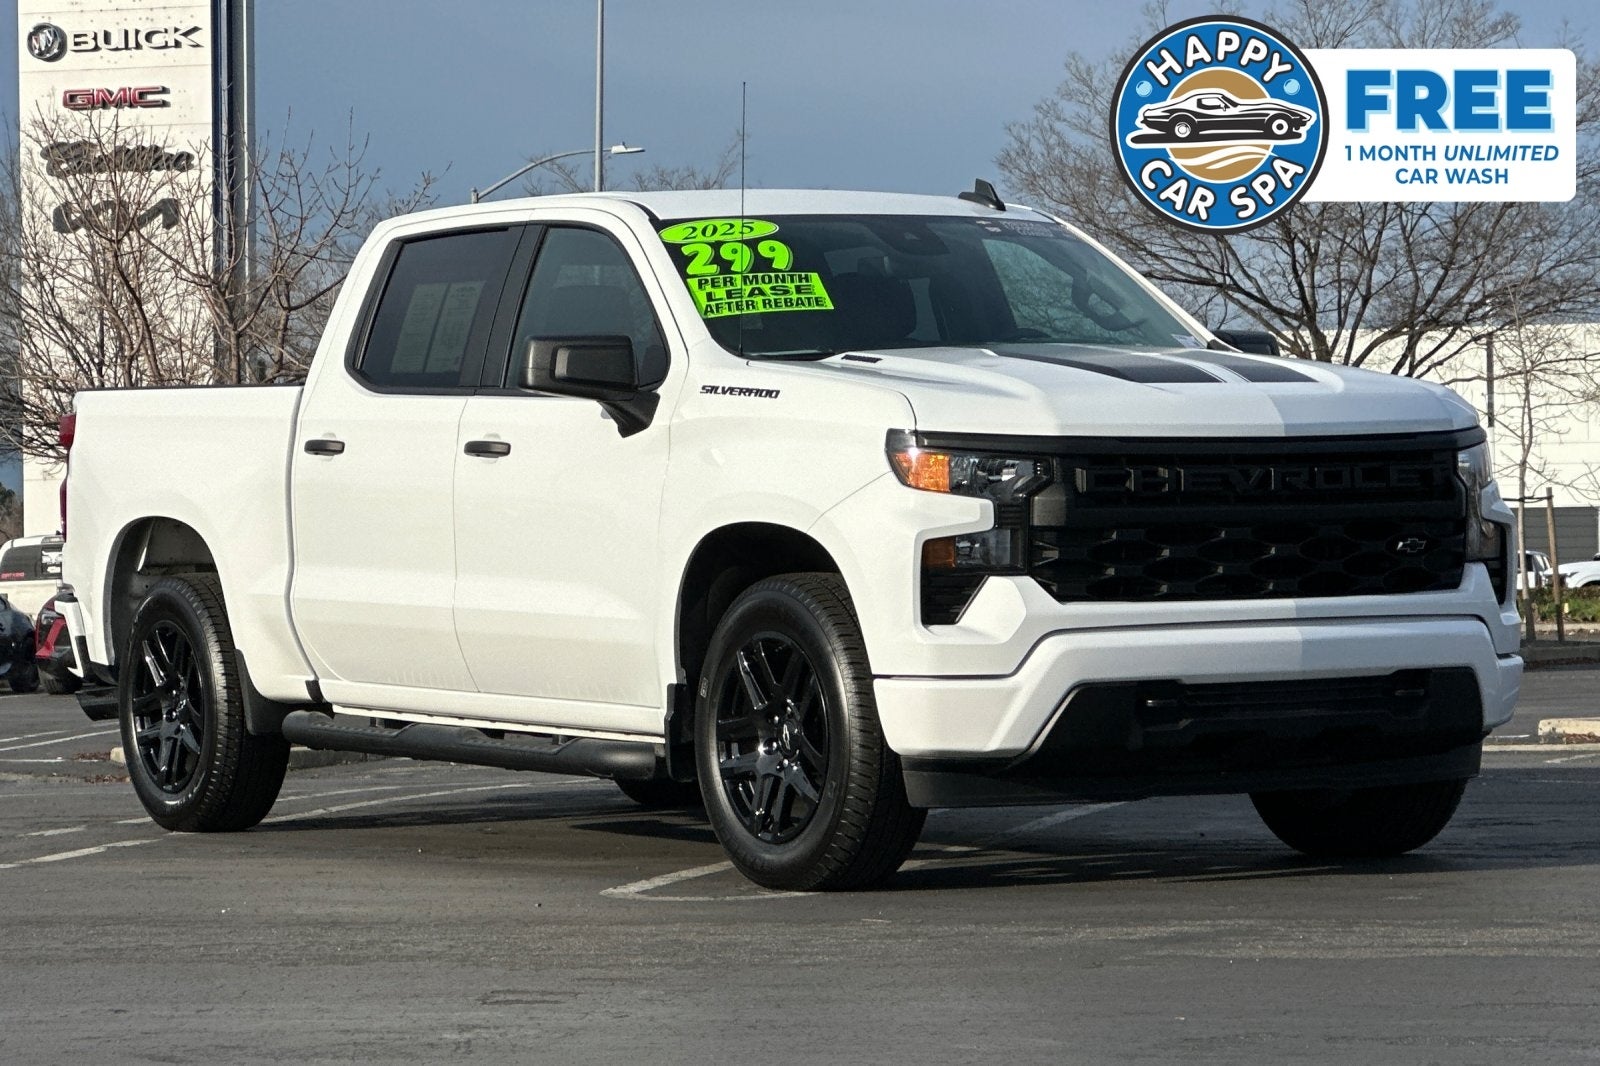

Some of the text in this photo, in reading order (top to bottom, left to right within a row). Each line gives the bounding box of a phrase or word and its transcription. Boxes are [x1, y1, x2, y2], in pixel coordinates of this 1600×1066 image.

[71, 26, 203, 52] BUICK
[62, 86, 168, 110] GMC
[682, 222, 755, 240] 2025
[681, 240, 793, 275] 299
[697, 274, 811, 290] PER MONTH
[705, 284, 815, 302] LEASE
[703, 297, 826, 316] AFTER REBATE
[700, 385, 780, 399] SILVERADO
[1074, 463, 1450, 494] CHEVROLET
